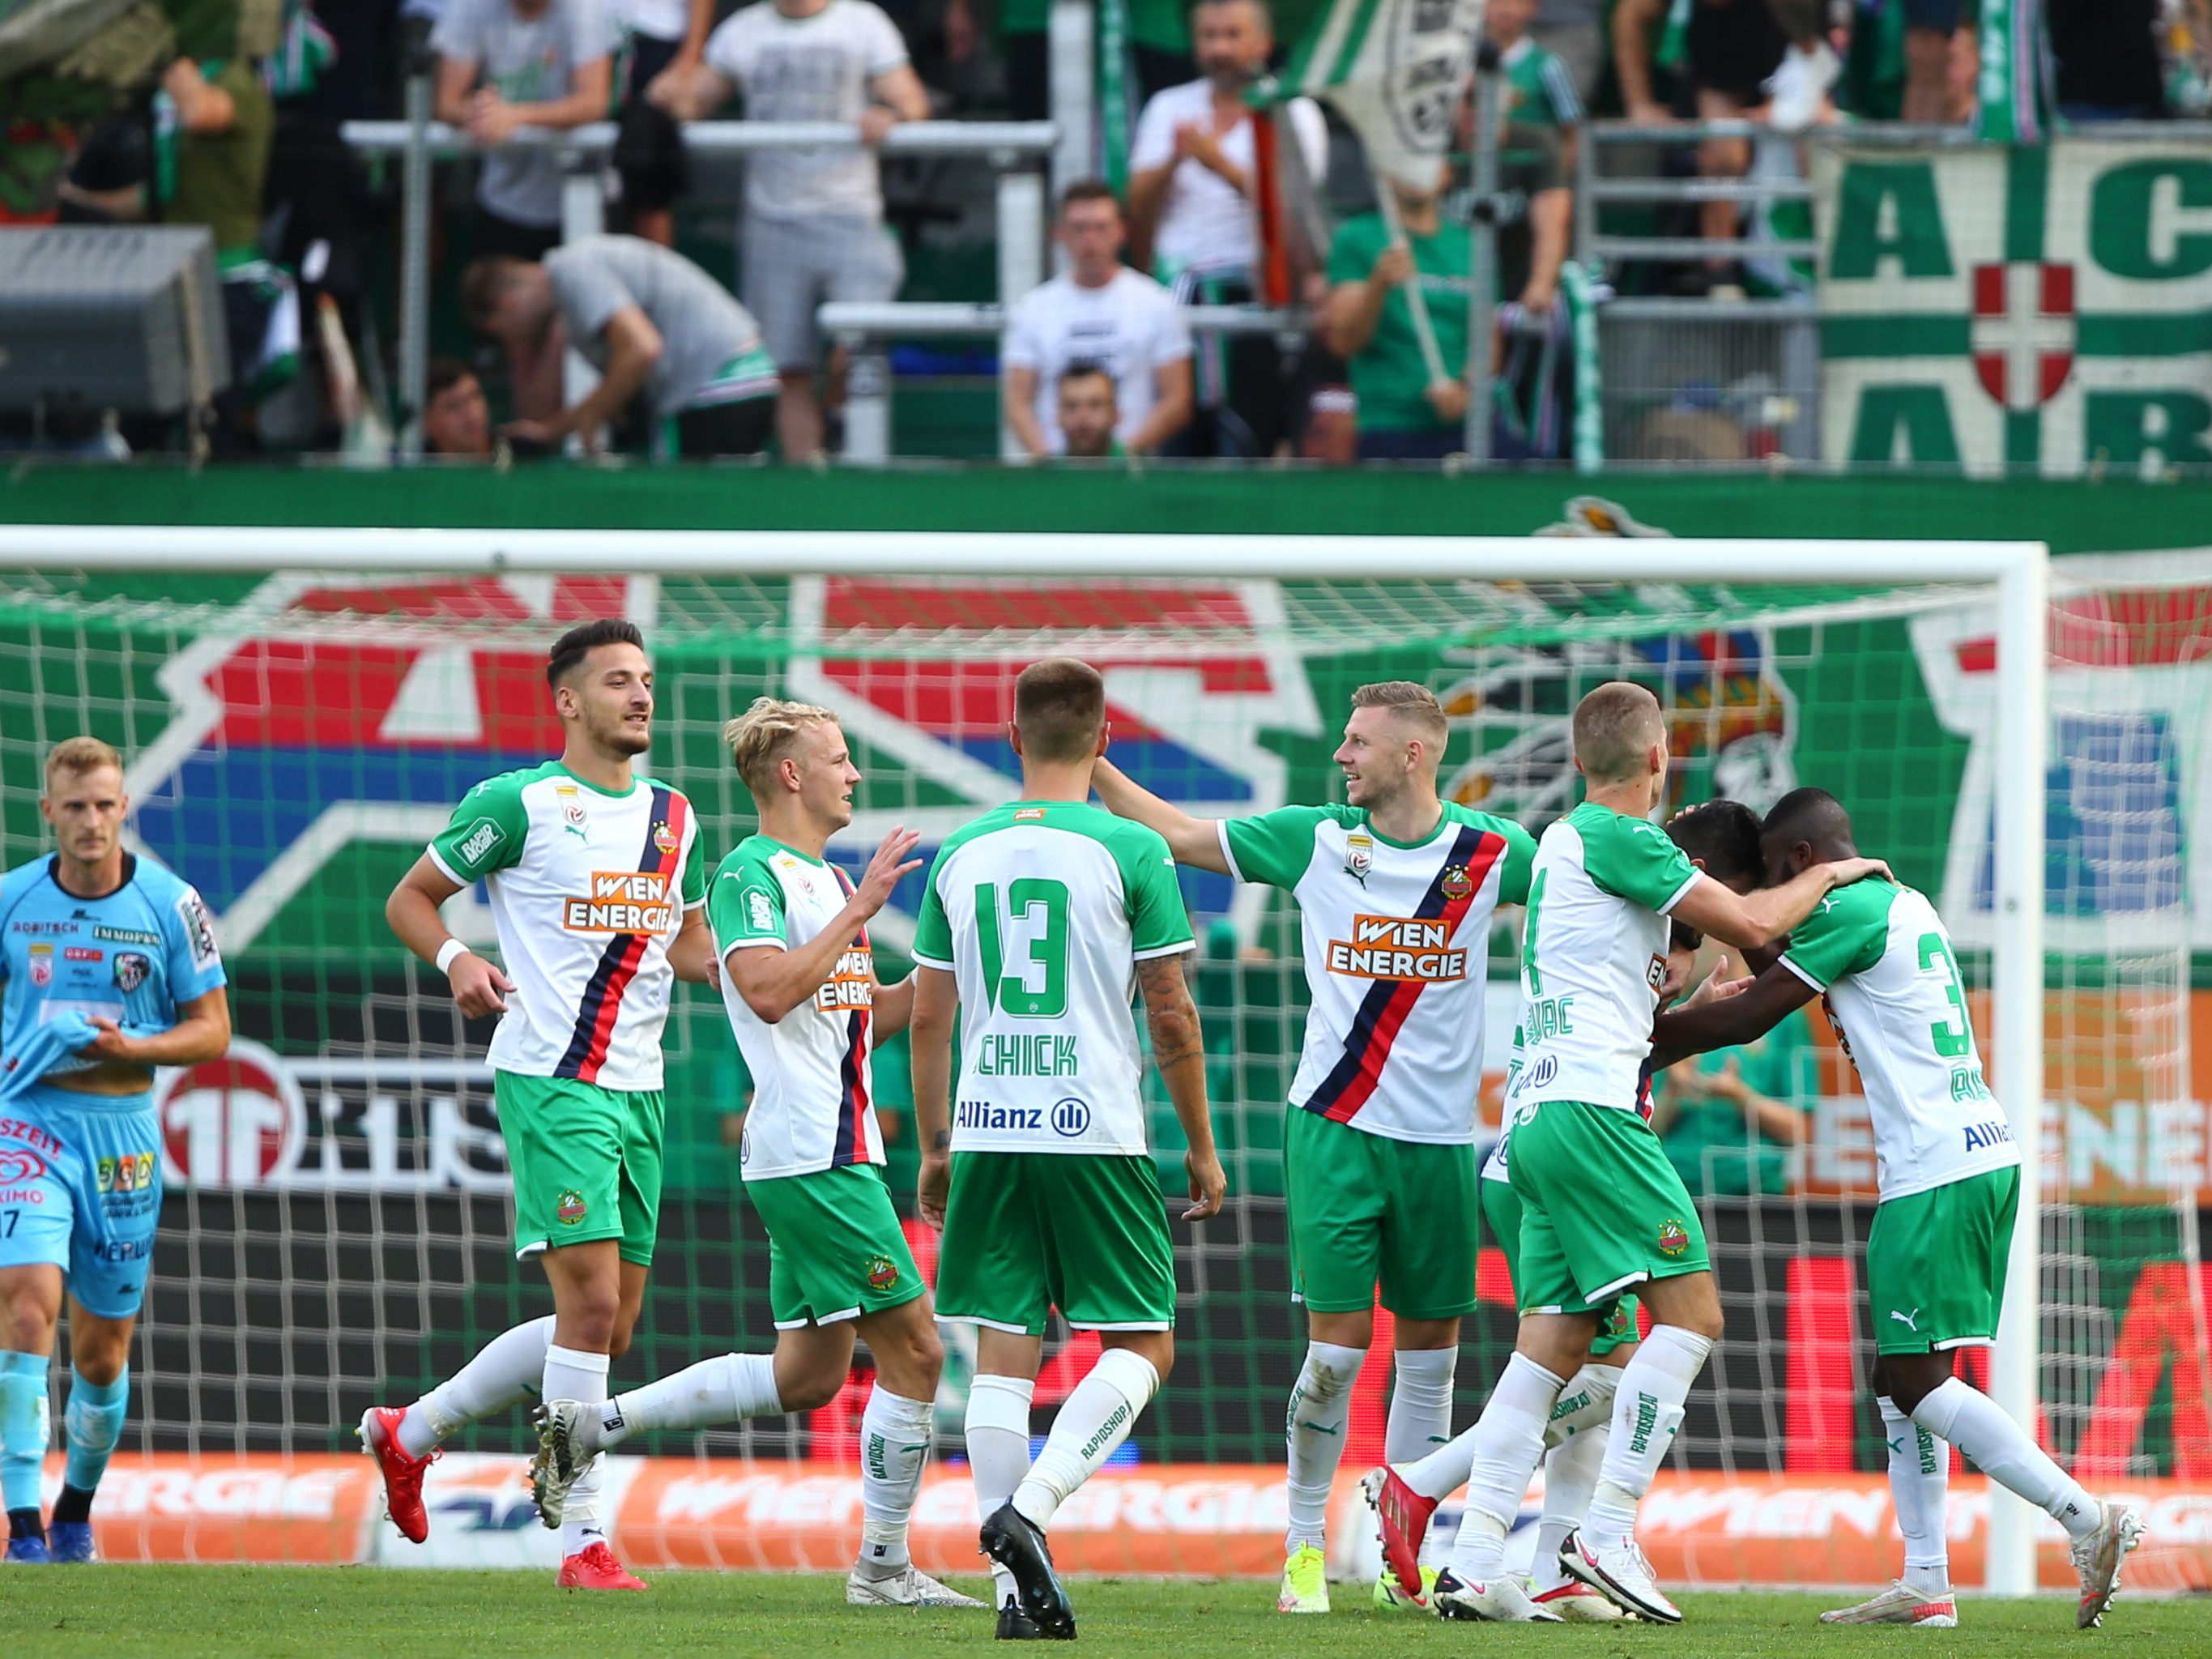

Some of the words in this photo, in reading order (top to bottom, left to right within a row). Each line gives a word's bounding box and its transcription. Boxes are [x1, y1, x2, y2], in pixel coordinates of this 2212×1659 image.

[595, 872, 665, 902] WIEN
[569, 902, 670, 933] ENERGIE
[974, 877, 1072, 1019] 13
[1357, 919, 1445, 949] WIEN
[1330, 943, 1464, 977] ENERGIE
[973, 1034, 1078, 1077] CHICK
[957, 1101, 1042, 1130] Allianz
[1630, 1390, 1659, 1454] RAPIDSHOP.AT
